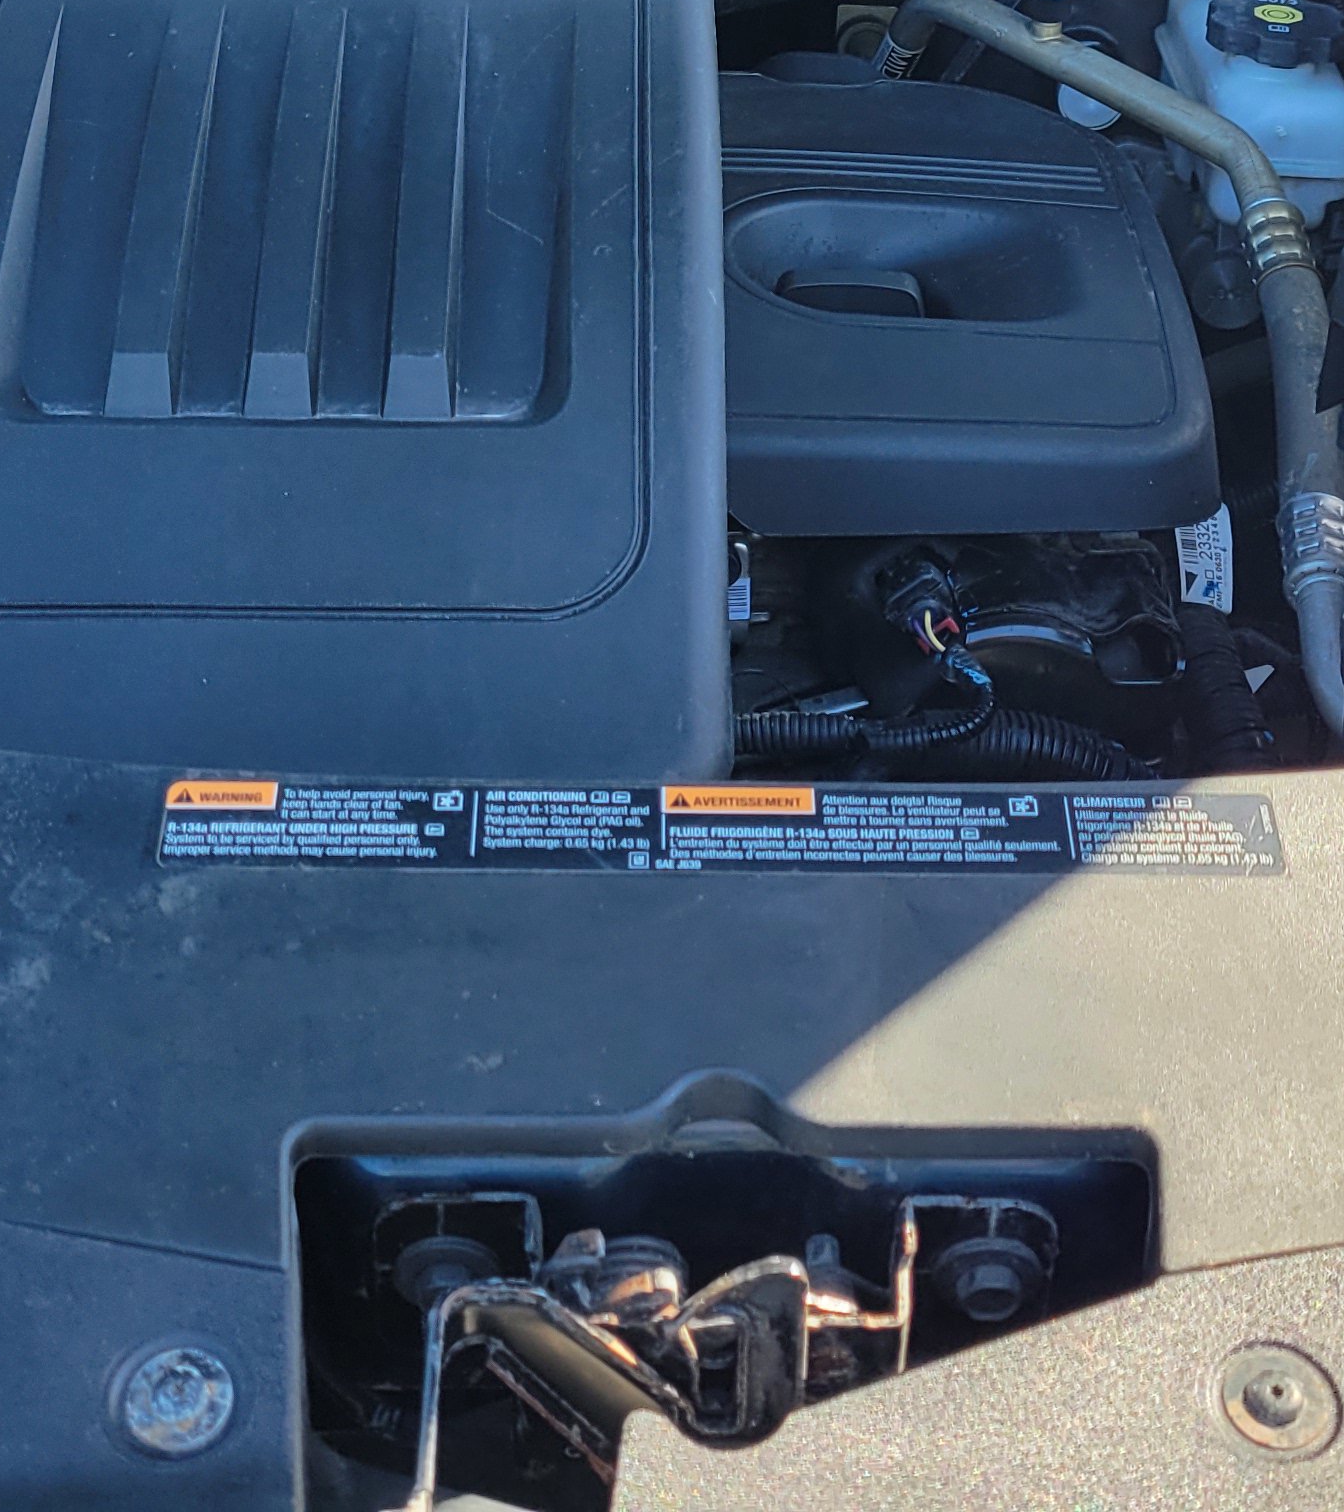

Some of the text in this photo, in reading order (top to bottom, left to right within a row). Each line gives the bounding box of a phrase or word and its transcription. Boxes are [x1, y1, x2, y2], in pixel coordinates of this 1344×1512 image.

[199, 792, 263, 802] WARNING
[284, 788, 296, 799] To
[298, 789, 321, 801] help
[323, 789, 350, 800] avoid
[353, 790, 397, 802] personal
[486, 791, 587, 803] AIR CONDITIONING
[822, 794, 867, 806] Attention
[869, 796, 888, 806] aux
[927, 795, 962, 807] Risque
[283, 799, 308, 811] keep
[310, 799, 342, 809] hands
[344, 800, 369, 810] clear
[371, 800, 382, 809] of
[693, 796, 802, 808] AVERTISSEMENT
[1073, 796, 1146, 808] CLIMATISEUR
[291, 810, 309, 819] can
[312, 809, 336, 820] start
[338, 810, 349, 820] at
[351, 811, 370, 821] any
[485, 804, 650, 816] Use only R-134a Refrigerant and
[822, 805, 836, 815] de
[892, 806, 904, 816] Le
[907, 806, 960, 816] ventilateur
[963, 806, 986, 817] peut
[988, 807, 1000, 816] se
[1075, 809, 1208, 821] Utiliser seulement le fluide
[484, 815, 548, 826] Polyalkylene
[550, 815, 581, 826] Glycol
[584, 815, 596, 826] oil
[599, 816, 623, 827] (PAG
[823, 816, 857, 825] mettre
[869, 816, 906, 826] tourner
[908, 816, 932, 826] sans
[1133, 820, 1172, 832] R-134a
[1174, 821, 1184, 832] et
[1187, 821, 1200, 832] de
[167, 822, 419, 835] R-134a REFRIGERANT UNDER HIGH PRESSURE
[485, 825, 504, 836] The
[506, 826, 542, 837] system
[545, 826, 589, 837] contains
[669, 826, 708, 837] FLUIDE
[786, 827, 826, 839] R-134a
[828, 827, 858, 839] SOUS
[860, 828, 897, 840] HAUTE
[899, 828, 954, 840] PRESSION
[165, 833, 204, 845] System
[207, 834, 217, 844] to
[220, 834, 233, 844] be
[236, 834, 280, 845] serviced
[282, 835, 295, 847] by
[297, 835, 342, 847] qualified
[344, 835, 394, 846] personnel
[483, 837, 522, 849] System
[591, 838, 605, 850] kg
[636, 838, 650, 850] lb)
[726, 838, 739, 848] du
[787, 839, 806, 849] doit
[876, 841, 894, 851] par
[896, 841, 909, 850] un
[912, 841, 962, 851] personnel
[163, 845, 210, 857] Improper
[212, 846, 251, 856] service
[253, 845, 298, 856] methods
[301, 847, 324, 858] may
[326, 847, 357, 857] cause
[359, 846, 404, 858] personal
[1080, 842, 1092, 852] Le
[1140, 842, 1182, 854] contient
[1184, 842, 1197, 853] du
[670, 849, 690, 859] Des
[804, 850, 861, 861] incorrectes
[863, 851, 904, 863] peuvent
[906, 852, 941, 862] causer
[943, 851, 962, 862] des
[1081, 852, 1118, 865] Charge
[1120, 853, 1134, 864] du
[1214, 853, 1228, 866] kg
